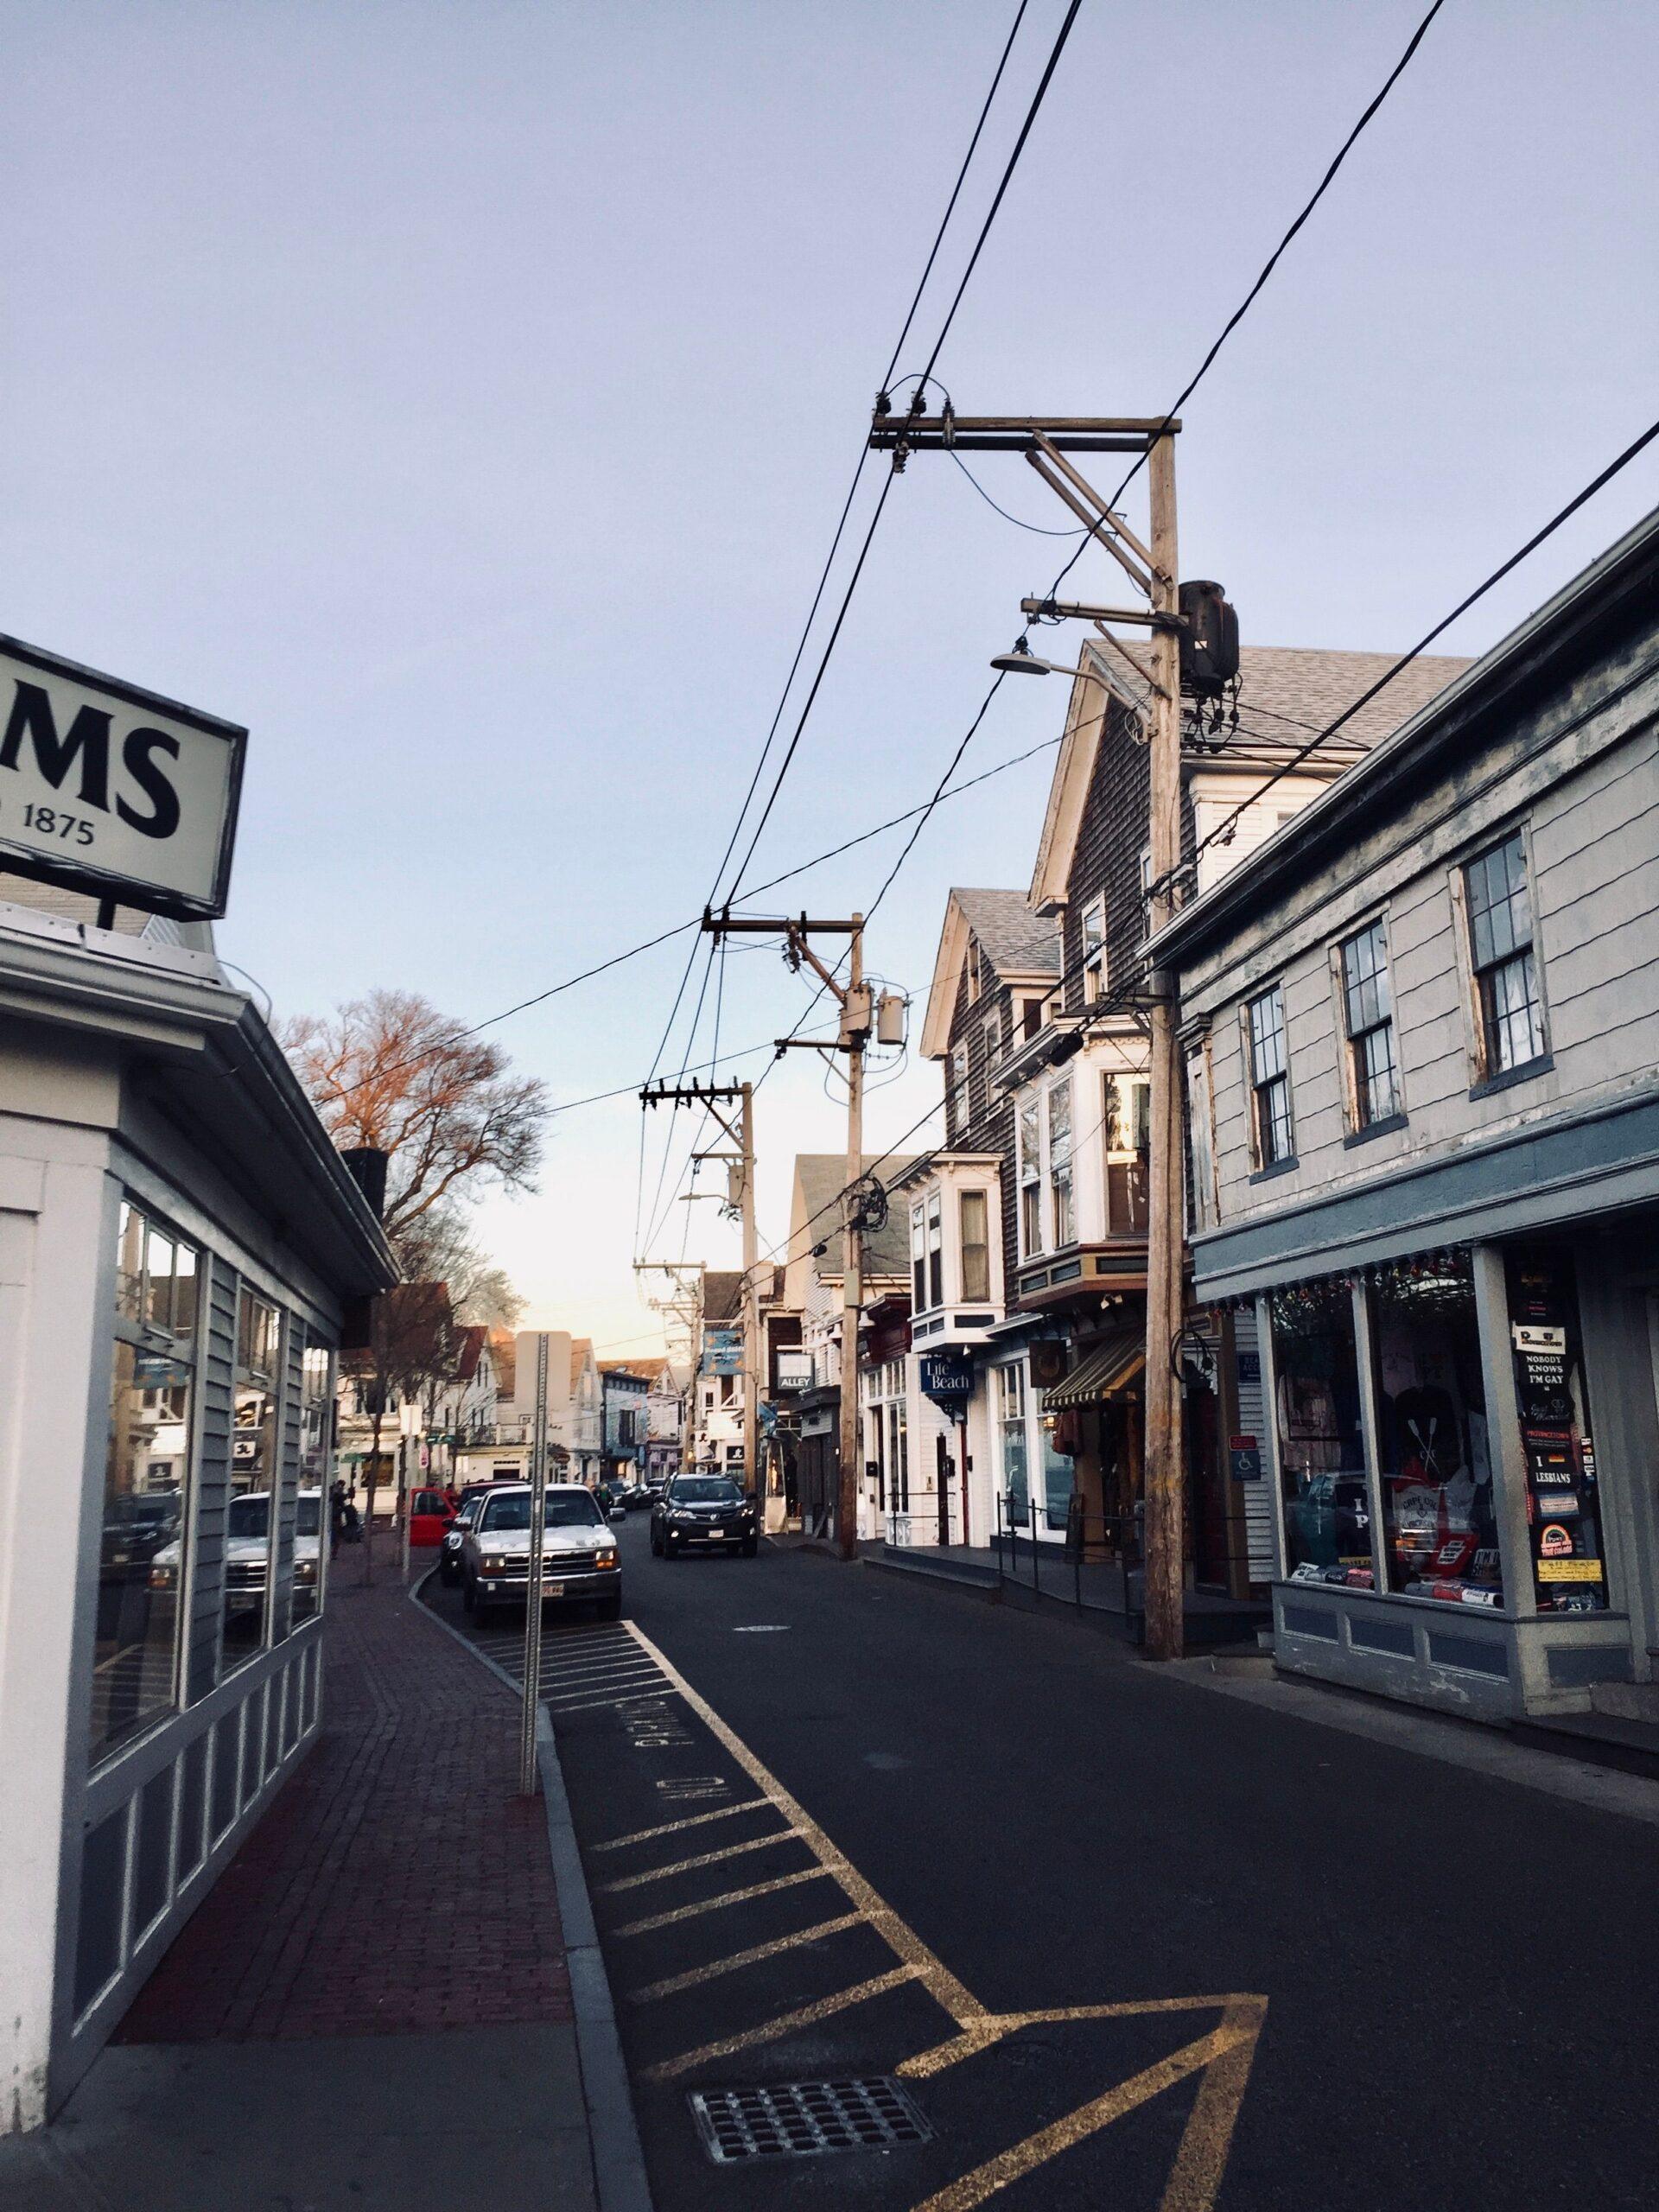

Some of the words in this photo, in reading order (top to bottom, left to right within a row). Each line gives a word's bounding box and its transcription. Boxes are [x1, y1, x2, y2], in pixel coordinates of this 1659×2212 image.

[23, 803, 95, 846] 1875
[1526, 1355, 1562, 1364] NOBODY
[1528, 1364, 1564, 1374] KNOWS
[780, 1377, 810, 1388] ALLEY
[932, 1375, 969, 1389] Beach
[1529, 1376, 1543, 1384] I'M
[1544, 1376, 1564, 1384] GAY
[1535, 1471, 1571, 1484] LESBIANS
